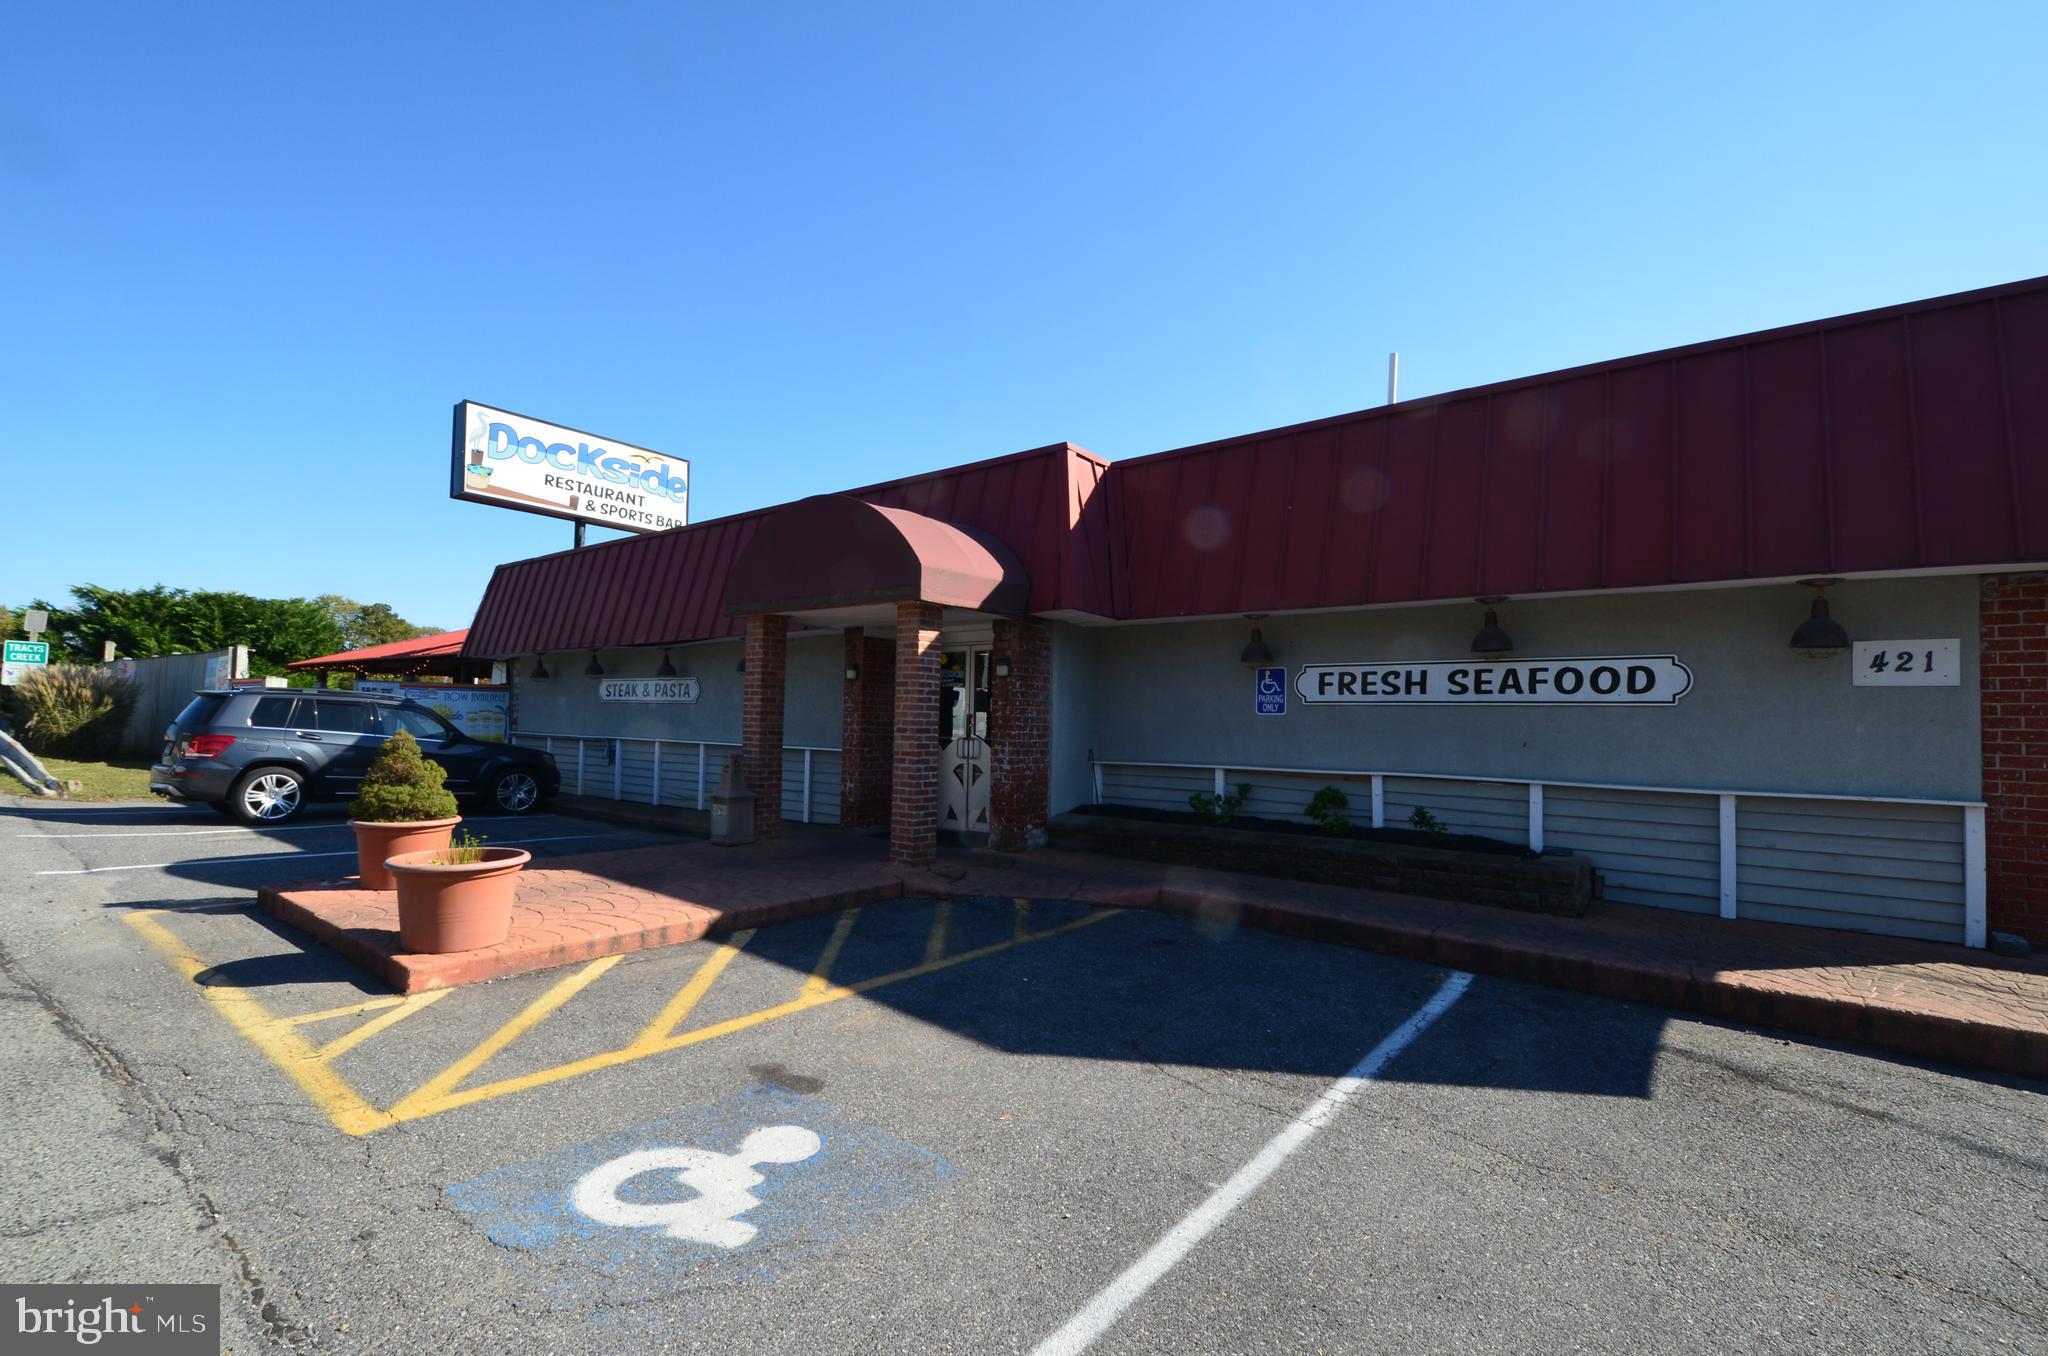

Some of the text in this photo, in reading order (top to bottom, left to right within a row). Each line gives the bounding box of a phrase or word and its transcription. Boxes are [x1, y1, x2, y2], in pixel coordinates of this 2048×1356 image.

[544, 474, 647, 507] RESTAURANT
[585, 499, 682, 528] & SPORTS BAR
[8, 643, 45, 653] TRACYS
[10, 653, 41, 661] CREEK
[1869, 650, 1934, 673] 421
[1318, 665, 1656, 696] FRESH SEAFOOD
[605, 683, 690, 698] STEAK & PASTA
[1258, 695, 1284, 703] PARKING
[1262, 703, 1279, 712] ONLY
